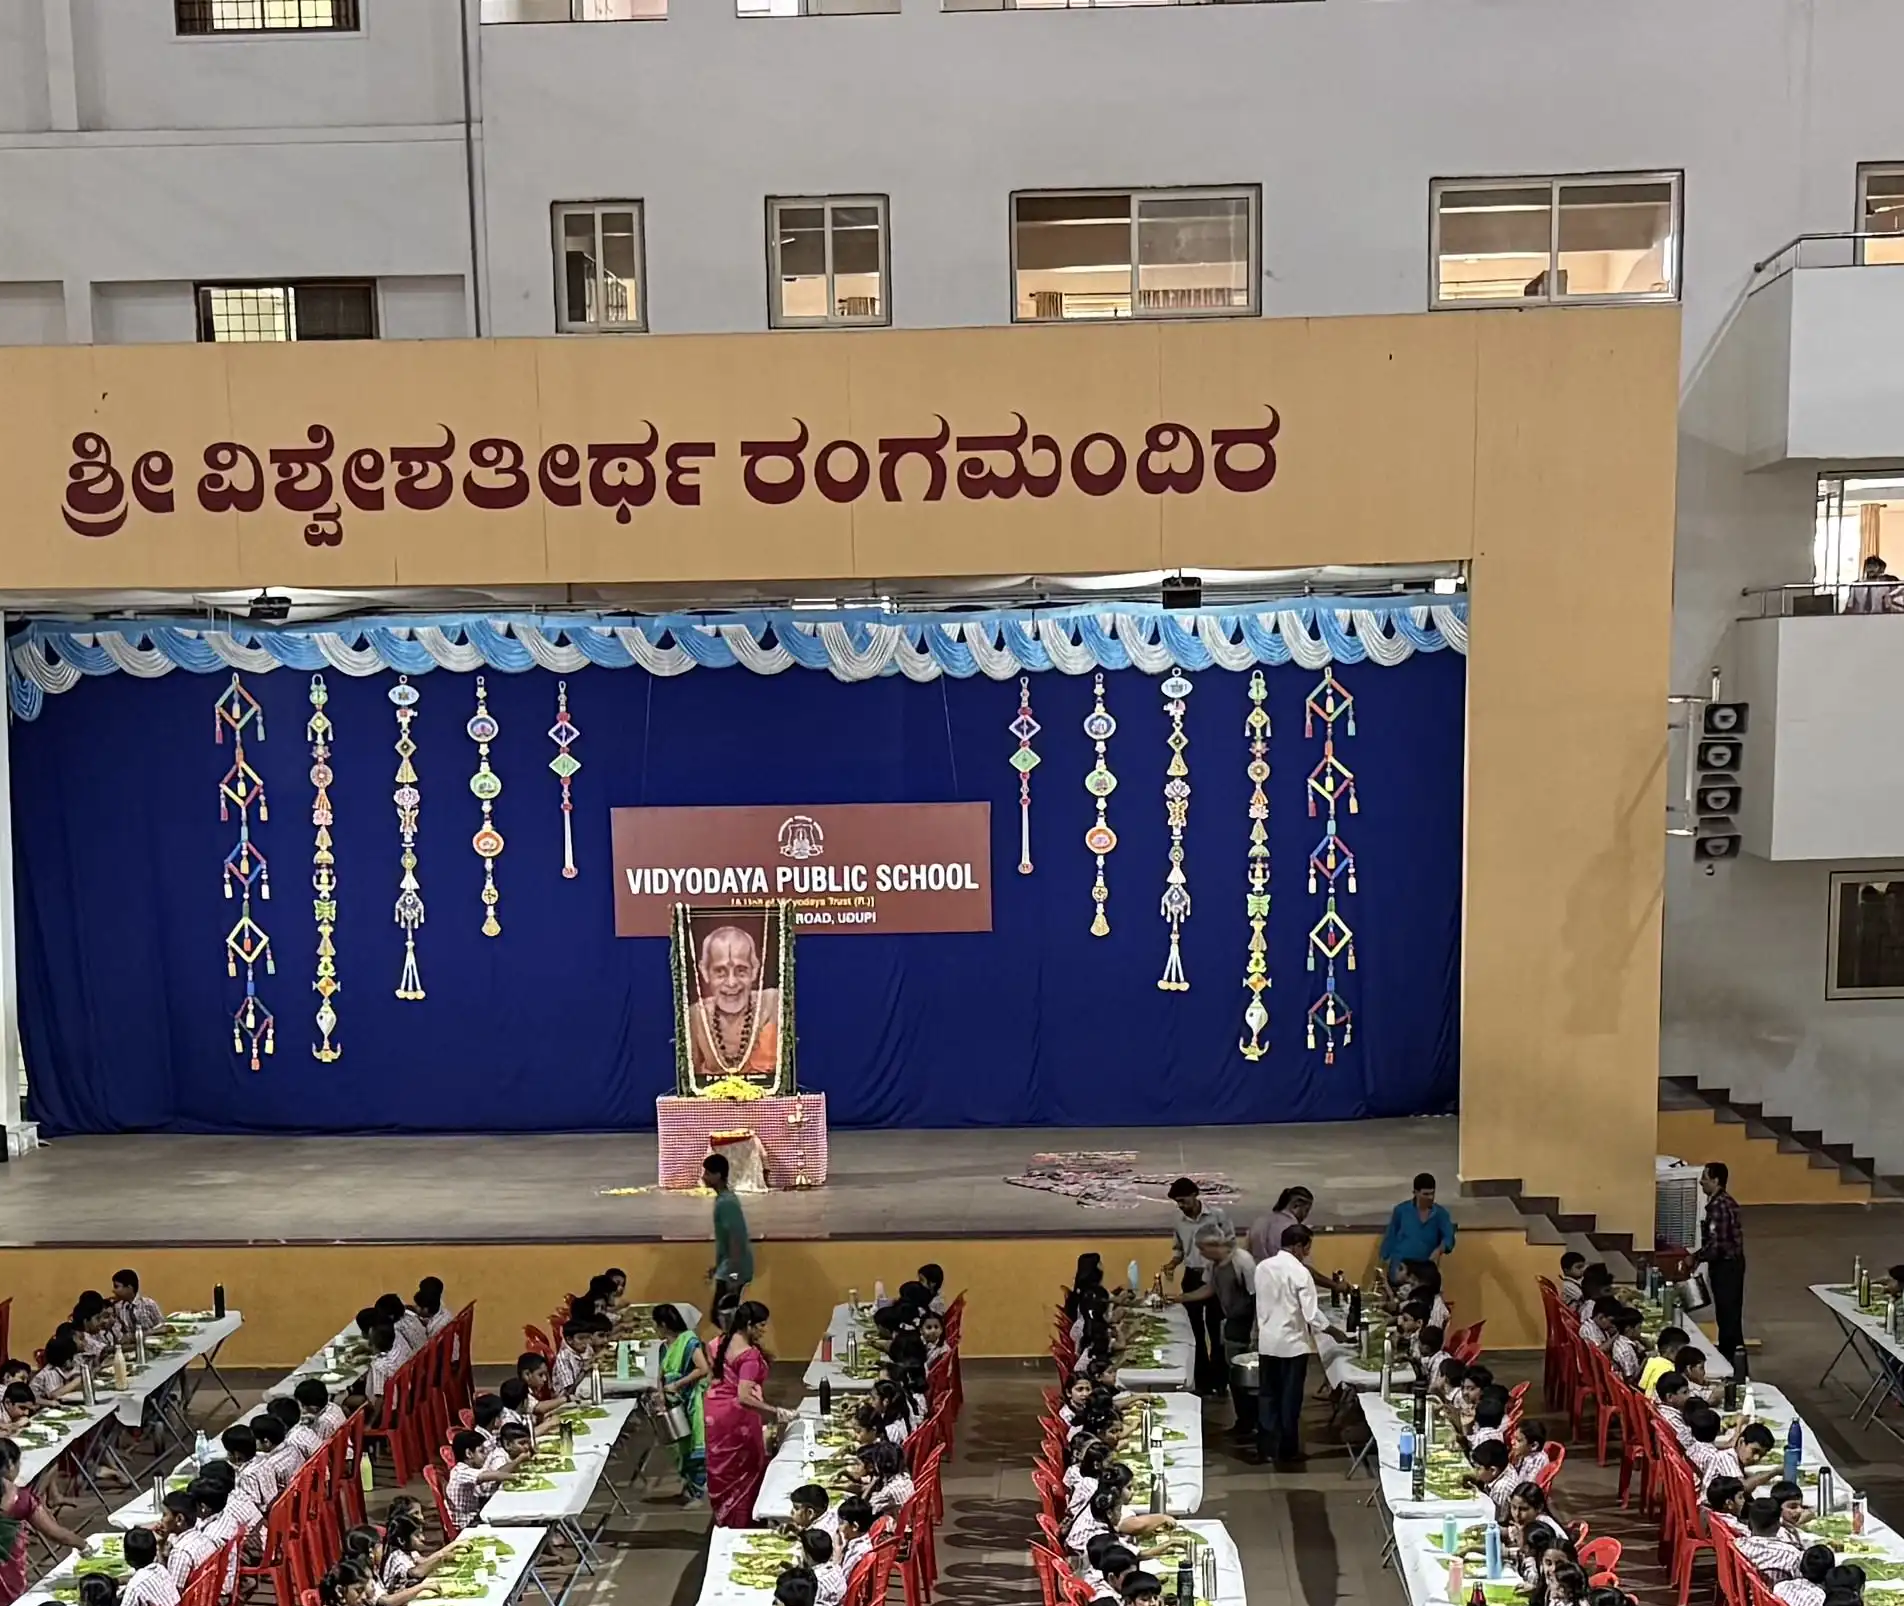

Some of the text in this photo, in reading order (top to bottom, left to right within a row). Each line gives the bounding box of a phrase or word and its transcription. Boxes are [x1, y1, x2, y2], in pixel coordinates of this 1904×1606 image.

[60, 403, 1282, 549] ಶ್ರೀ ವಿಶ್ವೇಶತೀರ್ಥ ರಂಗಮಂದಿರ
[625, 862, 980, 896] VIDYODAYA PUBLIC SCHOOL
[795, 911, 877, 925] ROAD, UDUPI
